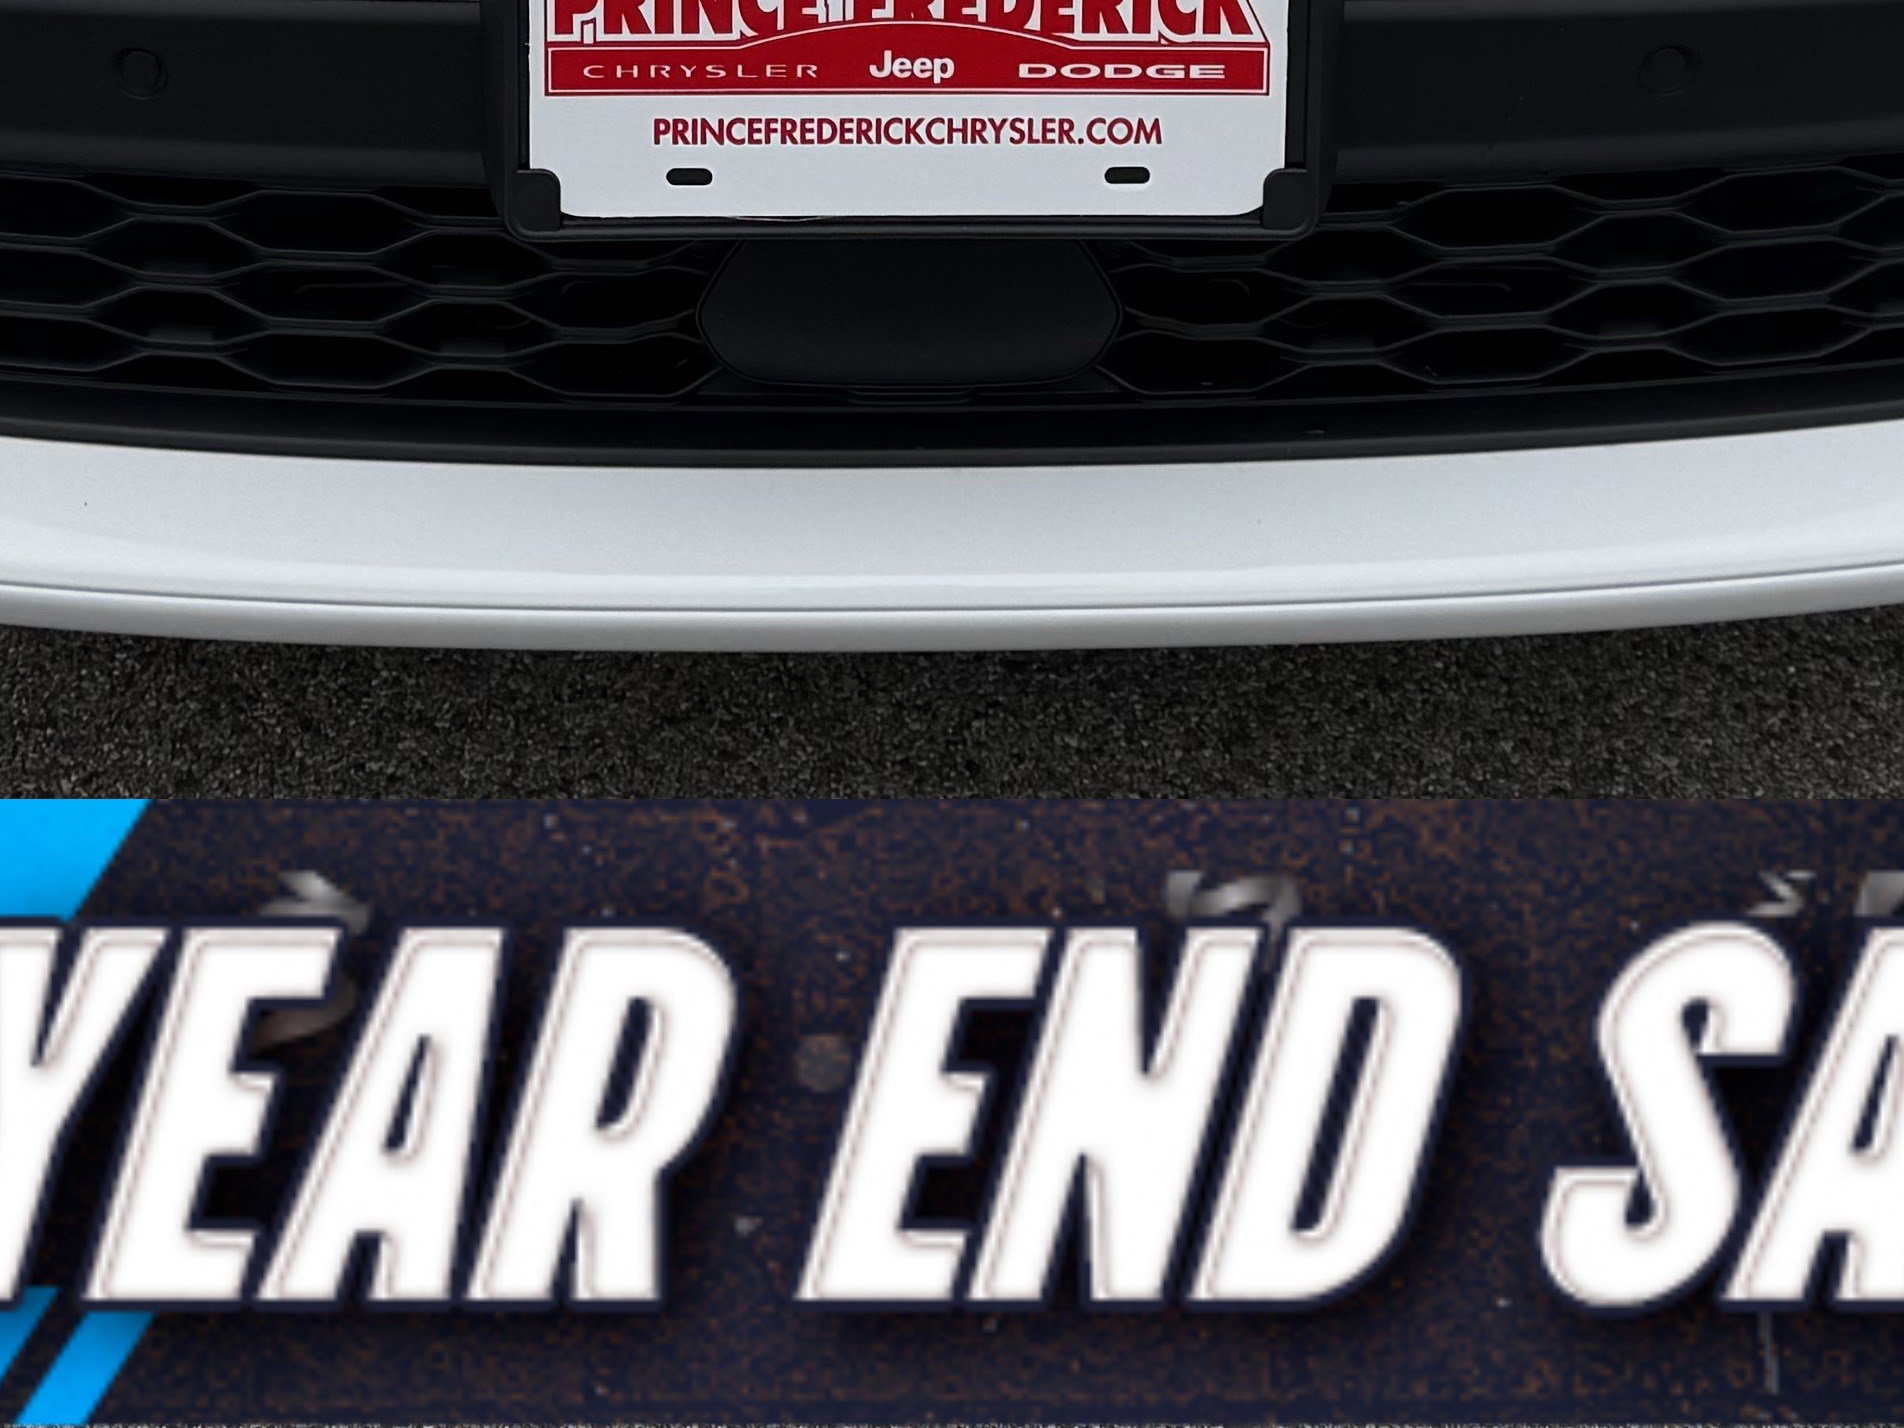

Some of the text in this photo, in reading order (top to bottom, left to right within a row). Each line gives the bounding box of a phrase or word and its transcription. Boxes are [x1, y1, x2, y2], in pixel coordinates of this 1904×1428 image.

[582, 63, 819, 80] CHRYSLER
[869, 49, 956, 86] Jeep
[1017, 63, 1227, 80] DODGE
[652, 116, 1163, 147] PRINCEFREDERICKCHRYSLER.COM
